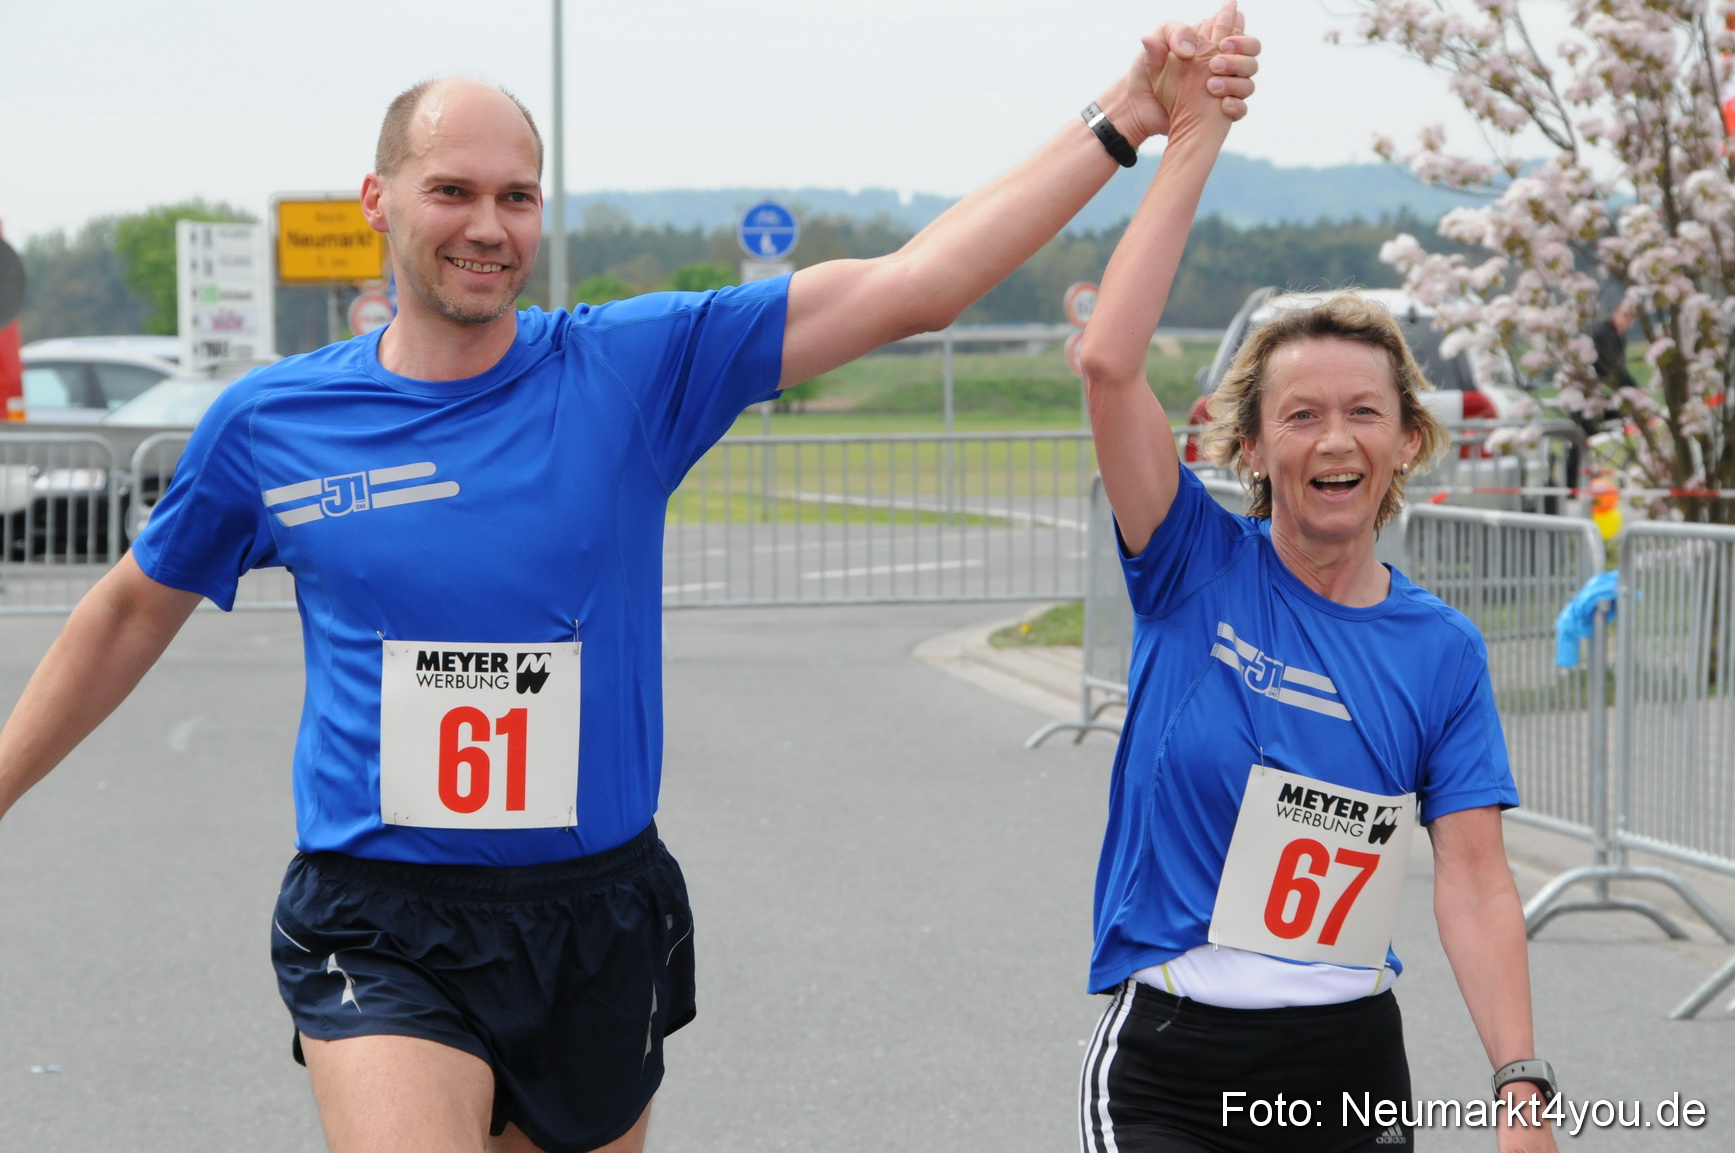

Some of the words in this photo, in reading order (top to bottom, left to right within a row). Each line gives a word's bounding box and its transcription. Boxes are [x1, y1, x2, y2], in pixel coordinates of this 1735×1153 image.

[416, 650, 509, 673] MEYER
[416, 673, 509, 689] WERBUNG
[438, 706, 528, 814] 61
[1278, 783, 1369, 822] MEYER
[1276, 803, 1364, 838] WERBUNG
[1264, 838, 1381, 946] 67
[1375, 1136, 1406, 1144] adidas
